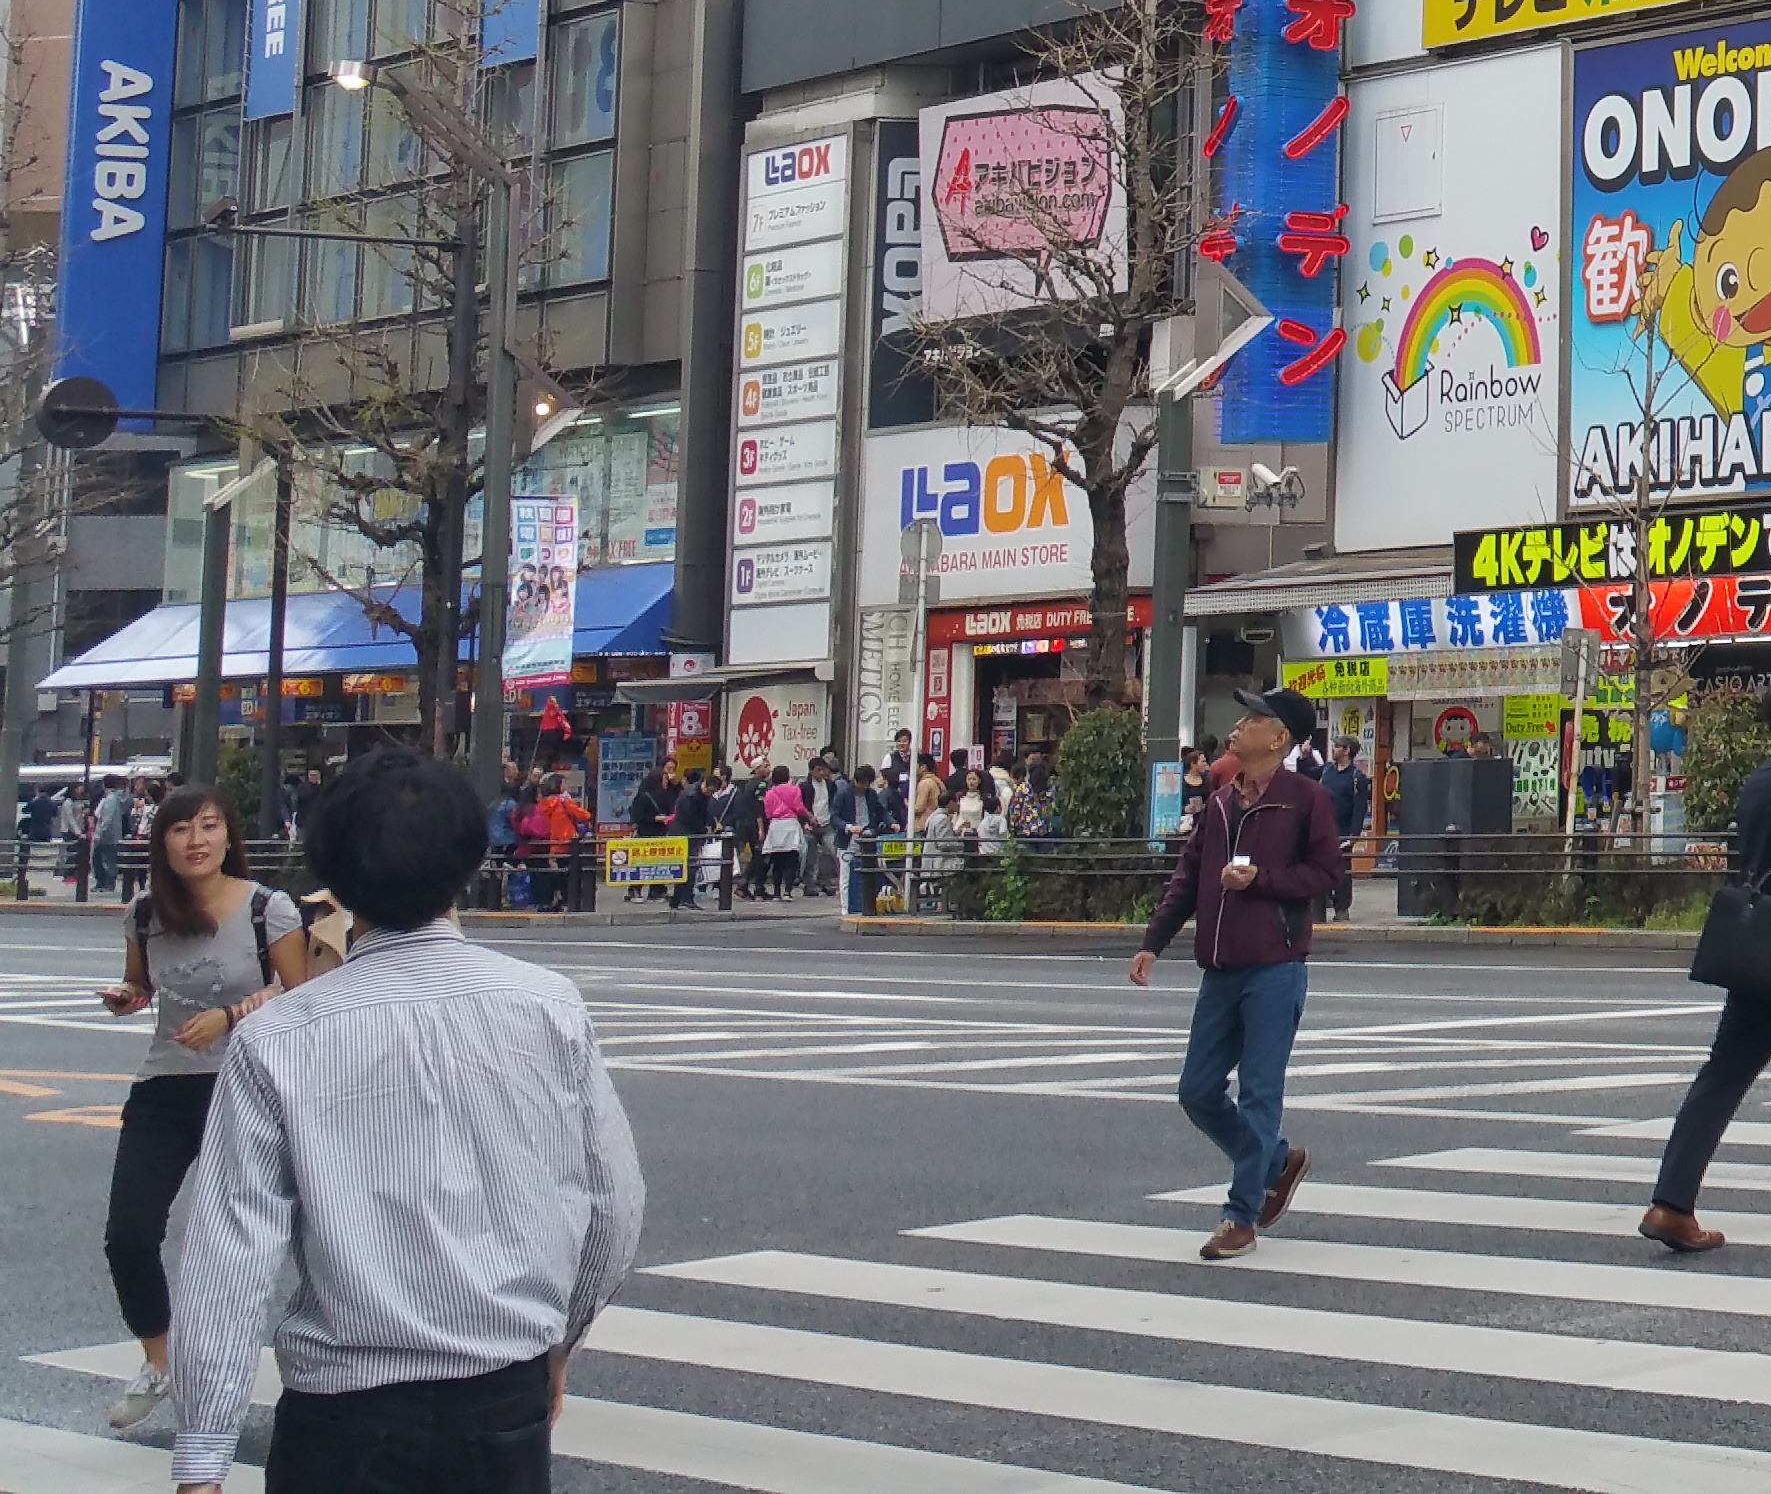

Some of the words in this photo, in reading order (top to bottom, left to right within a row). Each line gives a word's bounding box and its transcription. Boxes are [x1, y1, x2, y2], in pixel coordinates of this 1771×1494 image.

[90, 57, 155, 243] AKIBA
[974, 157, 1098, 193] アキバビジョン
[1440, 368, 1541, 405] Rainbow
[1444, 407, 1536, 434] SPECTRUM
[982, 547, 1017, 570] MAIN
[1021, 543, 1069, 566] STORE
[1046, 610, 1072, 627] DUTY
[1315, 600, 1437, 654] 冷蔵庫
[785, 699, 818, 719] Japan.
[782, 722, 818, 741] Tax-free
[1506, 722, 1525, 734] Duty
[793, 744, 817, 761] Shop
